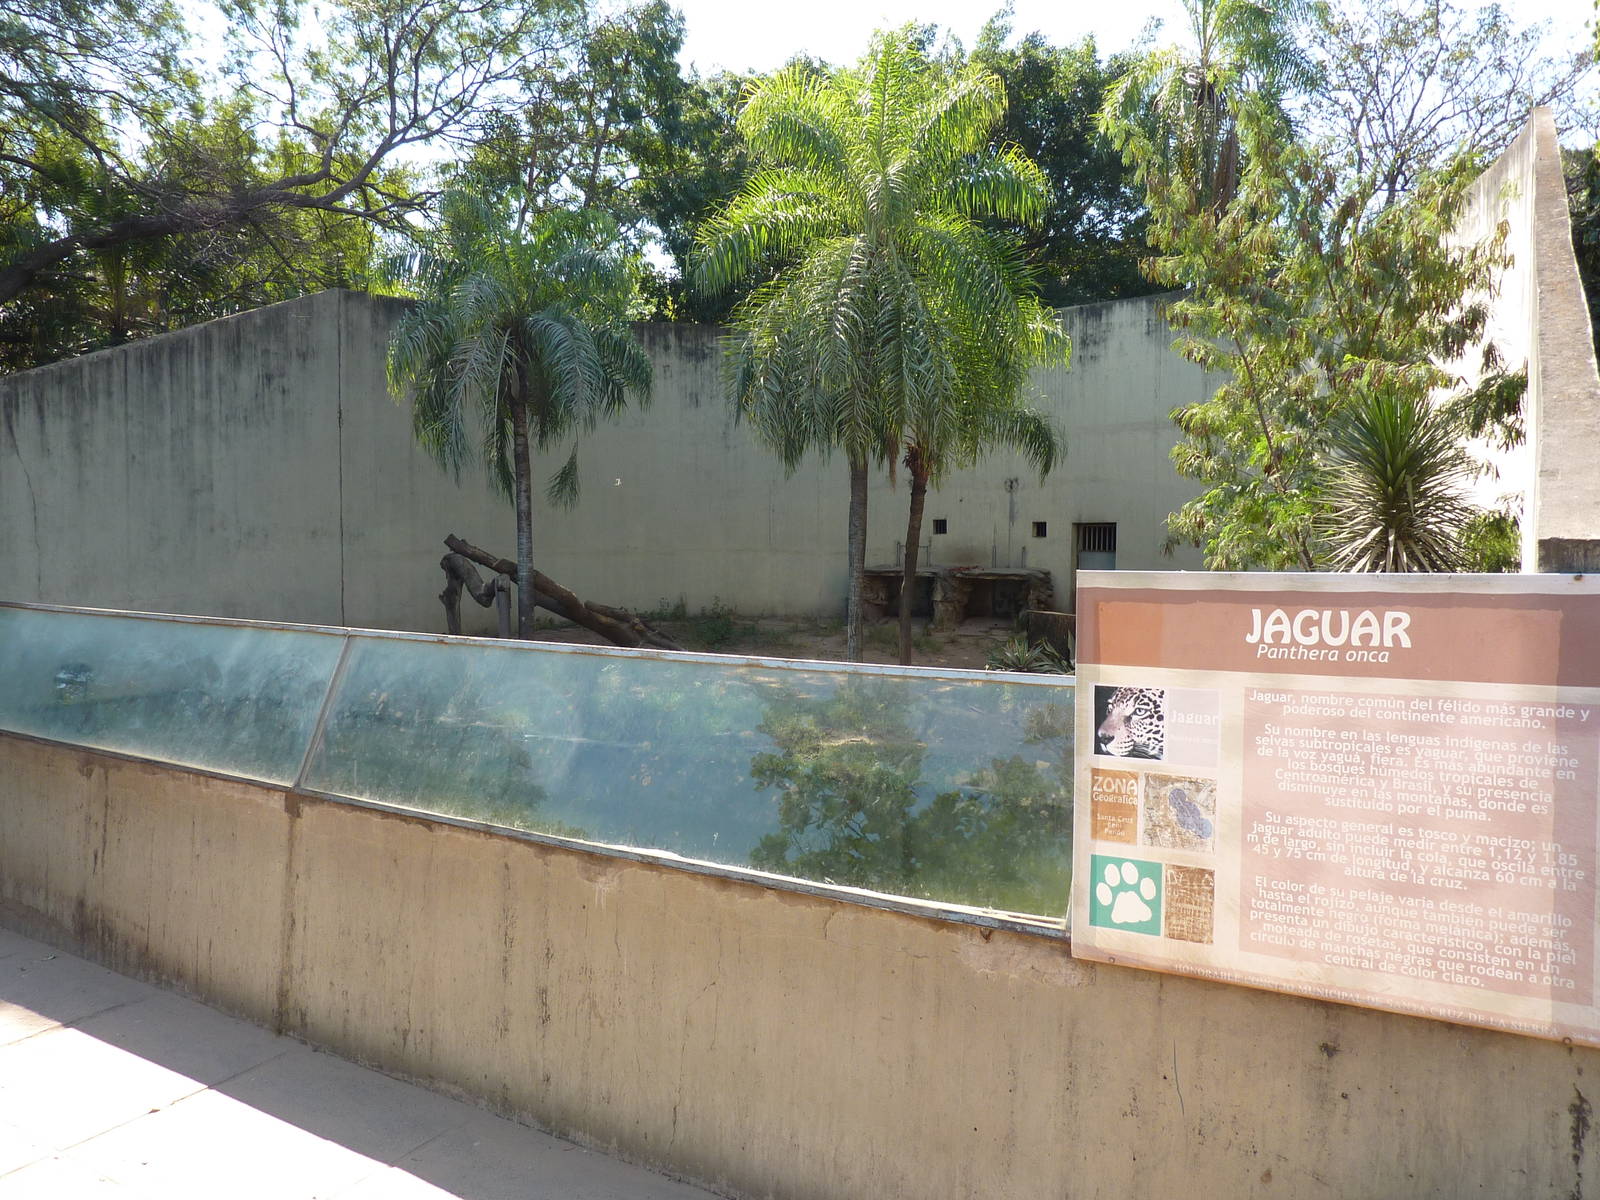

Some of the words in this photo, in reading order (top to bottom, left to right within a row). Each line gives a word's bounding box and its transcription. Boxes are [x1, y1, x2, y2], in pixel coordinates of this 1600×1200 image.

[1246, 608, 1412, 648] JAGUAR
[1257, 644, 1338, 661] Panthera
[1345, 649, 1389, 663] onca
[1170, 710, 1218, 726] Jaguar
[1249, 689, 1295, 705] Jaguar,
[1302, 694, 1352, 705] nombre
[1410, 698, 1432, 710] del
[1438, 699, 1480, 713] félido
[1486, 702, 1515, 715] más
[1520, 705, 1574, 718] grande
[1283, 703, 1344, 716] poderoso
[1350, 706, 1370, 718] del
[1375, 709, 1455, 723] continente
[1460, 714, 1545, 728] americano.
[1255, 734, 1294, 747] selvas
[1299, 738, 1391, 754] subtropicales
[1395, 745, 1410, 755] es
[1475, 751, 1502, 763] que
[1508, 753, 1578, 767] proviene
[1264, 723, 1279, 735] Su
[1284, 726, 1335, 738] nombre
[1340, 730, 1356, 740] en
[1363, 729, 1381, 742] las
[1387, 731, 1439, 747] lenguas
[1522, 740, 1541, 752] de
[1547, 741, 1568, 754] las
[1257, 744, 1272, 756] de
[1278, 746, 1288, 757] la
[1294, 749, 1316, 759] voz
[1371, 753, 1407, 766] fiera.
[1415, 756, 1431, 768] Es
[1434, 758, 1462, 771] más
[1469, 761, 1552, 778] abundante
[1556, 769, 1575, 780] en
[1287, 758, 1305, 770] los
[1310, 760, 1364, 775] bosques
[1439, 770, 1513, 787] tropicales
[1519, 776, 1537, 789] de
[1093, 776, 1138, 795] ZONA
[1275, 768, 1375, 787] Centroamérica
[1393, 777, 1435, 795] Brasil,
[1456, 785, 1471, 795] su
[1478, 787, 1552, 802] presencia
[1278, 779, 1346, 797] disminuye
[1351, 788, 1367, 798] en
[1373, 787, 1391, 800] las
[1478, 796, 1525, 812] donde
[1531, 803, 1548, 814] es
[1324, 797, 1392, 812] sustituido
[1398, 804, 1421, 816] por
[1427, 805, 1440, 816] el
[1445, 808, 1491, 821] puma.
[1252, 821, 1293, 836] jaguar
[1297, 826, 1340, 840] adulto
[1345, 832, 1389, 846] puede
[1394, 837, 1435, 850] medir
[1440, 842, 1481, 855] entre
[1265, 811, 1280, 823] Su
[1285, 815, 1336, 829] aspecto
[1341, 821, 1392, 835] general
[1398, 827, 1413, 837] es
[1419, 826, 1456, 841] tosco
[1475, 834, 1535, 852] macizo;
[1541, 841, 1560, 852] un
[1252, 843, 1268, 855] 45
[1286, 846, 1300, 859] 75
[1306, 851, 1325, 861] cm
[1330, 851, 1347, 864] de
[1433, 864, 1489, 880] alcanza
[1495, 870, 1513, 883] 60
[1519, 875, 1542, 887] cm
[1563, 877, 1576, 891] la
[1263, 833, 1278, 845] de
[1326, 841, 1344, 853] sin
[1351, 842, 1394, 858] incluir
[1400, 848, 1412, 860] la
[1458, 856, 1486, 869] que
[1491, 860, 1535, 874] oscila
[1540, 865, 1584, 879] entre
[1344, 865, 1385, 880] altura
[1390, 869, 1407, 882] de
[1413, 872, 1424, 884] la
[1430, 876, 1467, 889] cruz.
[1251, 897, 1324, 917] totalmente
[1329, 909, 1368, 924] negro
[1255, 876, 1266, 887] El
[1271, 880, 1304, 892] color
[1309, 882, 1325, 895] de
[1330, 887, 1344, 897] su
[1350, 890, 1393, 905] pelaje
[1439, 899, 1482, 915] desde
[1488, 906, 1502, 918] el
[1507, 910, 1571, 927] amarillo
[1259, 887, 1293, 902] hasta
[1298, 893, 1309, 904] el
[1365, 903, 1416, 919] aunque
[1489, 919, 1536, 934] puede
[1541, 926, 1567, 938] ser
[1250, 909, 1307, 926] presenta
[1312, 918, 1328, 929] un
[1334, 919, 1377, 937] dibujo
[1494, 944, 1521, 956] con
[1527, 946, 1540, 959] la
[1546, 950, 1576, 964] piel
[1263, 922, 1319, 939] moteada
[1325, 929, 1341, 942] de
[1346, 934, 1400, 953] rosetas,
[1407, 943, 1433, 956] que
[1439, 948, 1510, 967] consisten
[1515, 958, 1534, 970] en
[1540, 962, 1559, 974] un
[1299, 936, 1316, 949] de
[1320, 942, 1380, 959] manchas
[1385, 951, 1432, 967] negras
[1437, 959, 1464, 972] que
[1470, 964, 1523, 981] rodean
[1542, 974, 1574, 989] otra
[1324, 953, 1373, 969] central
[1378, 959, 1395, 973] de
[1400, 965, 1437, 979] color
[1442, 970, 1484, 986] claro.
